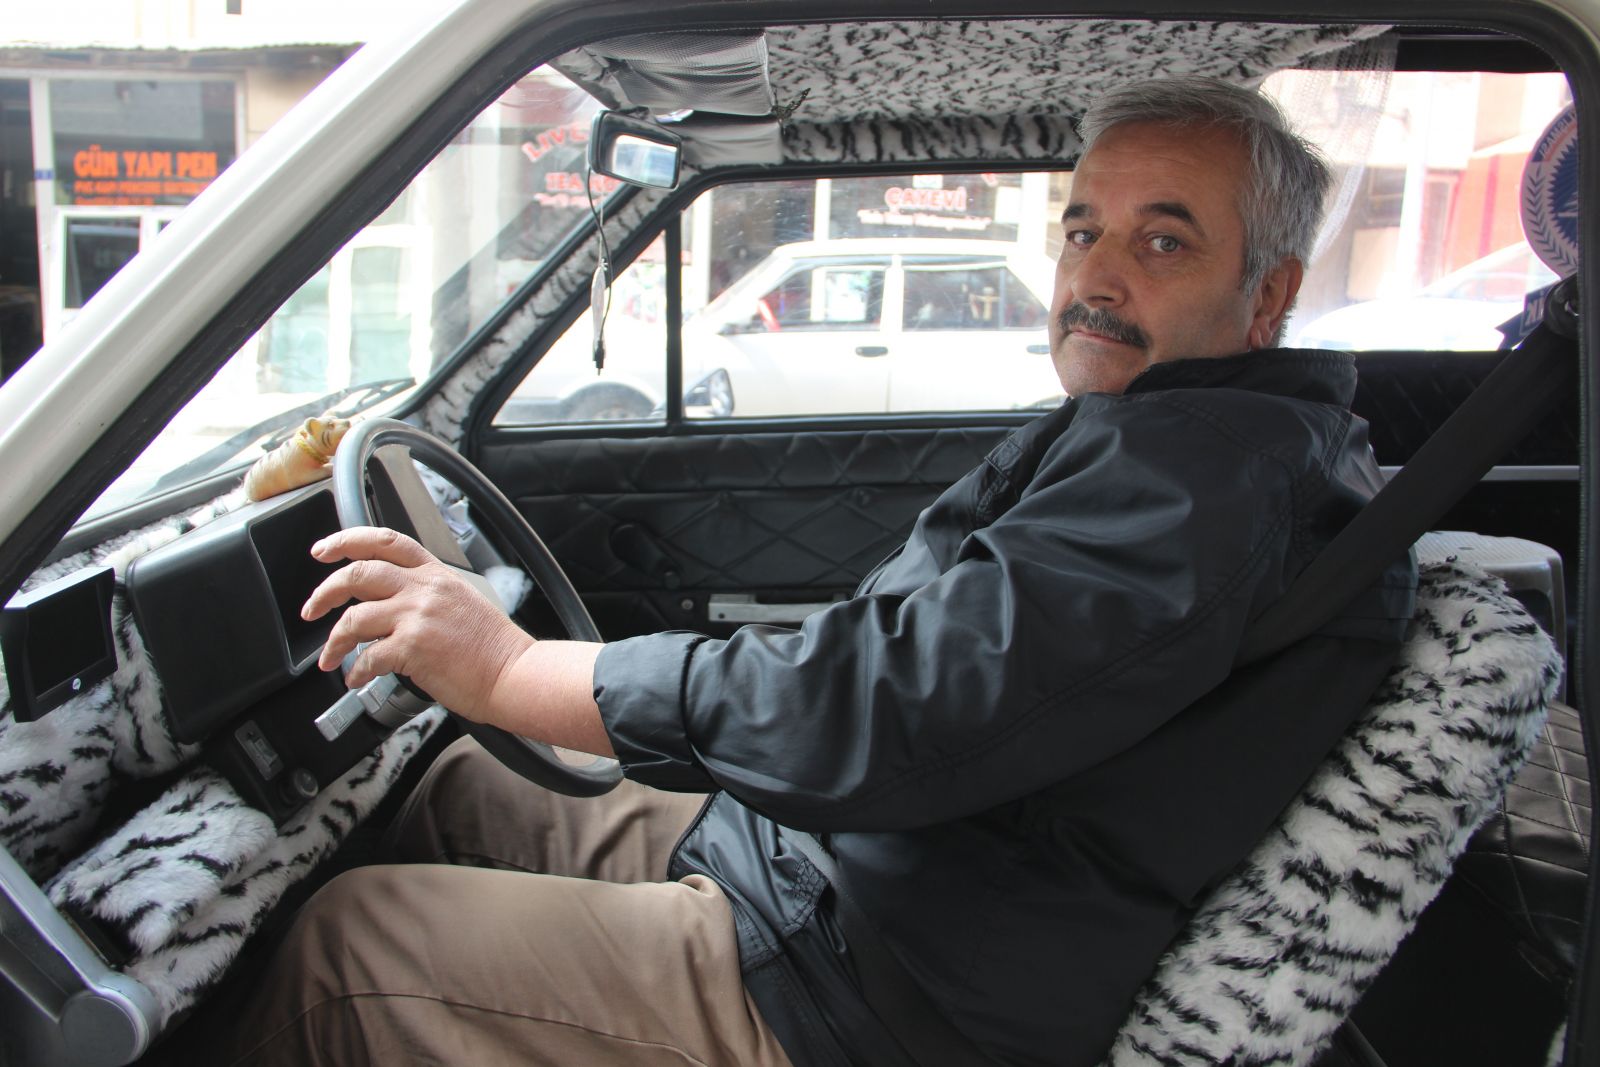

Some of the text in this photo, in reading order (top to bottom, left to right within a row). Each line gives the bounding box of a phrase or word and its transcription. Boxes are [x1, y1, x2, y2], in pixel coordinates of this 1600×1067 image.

[73, 144, 217, 178] GÜN YAPI PEN
